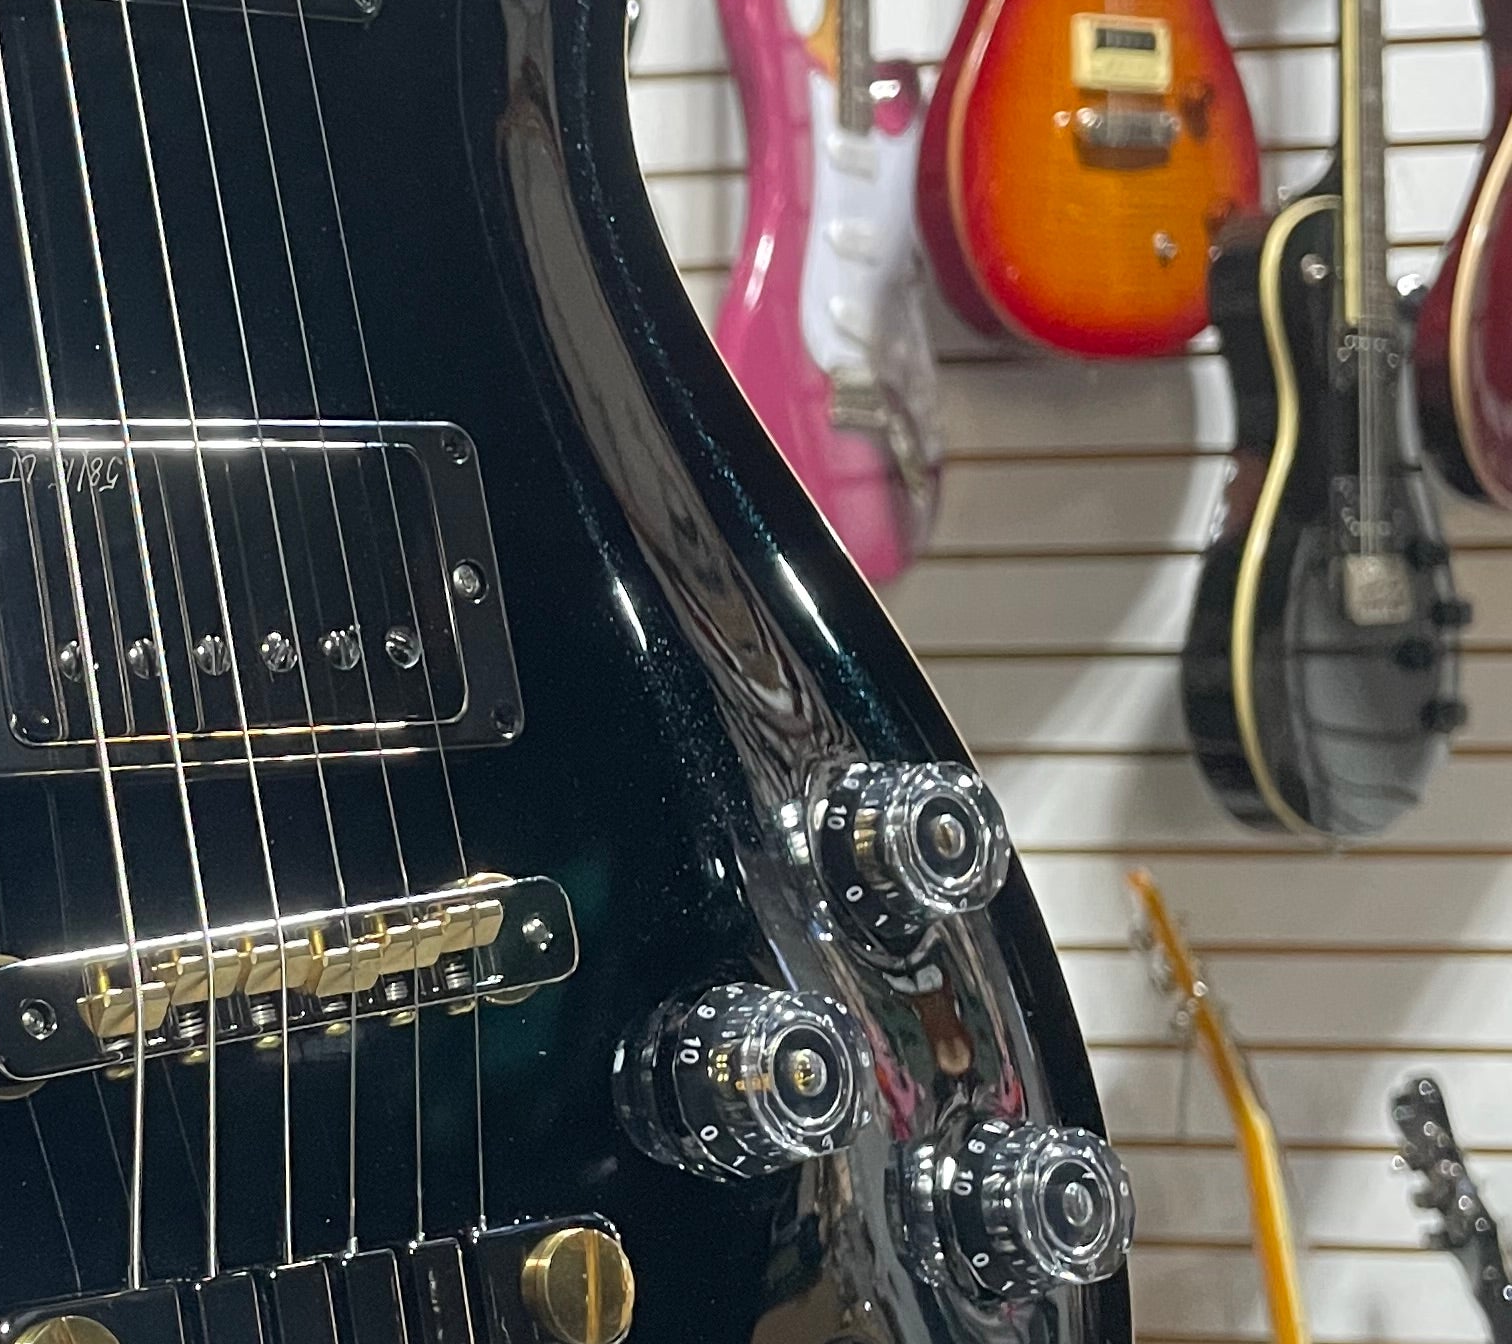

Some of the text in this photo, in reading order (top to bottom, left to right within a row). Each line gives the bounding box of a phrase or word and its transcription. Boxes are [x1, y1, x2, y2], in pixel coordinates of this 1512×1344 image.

[826, 804, 848, 830] 10
[845, 884, 864, 903] 0
[696, 1004, 717, 1019] 9
[679, 1035, 702, 1064] 10
[700, 1125, 719, 1142] 0
[967, 1138, 986, 1154] 9
[953, 1169, 974, 1196] 10
[972, 1252, 990, 1268] 0
